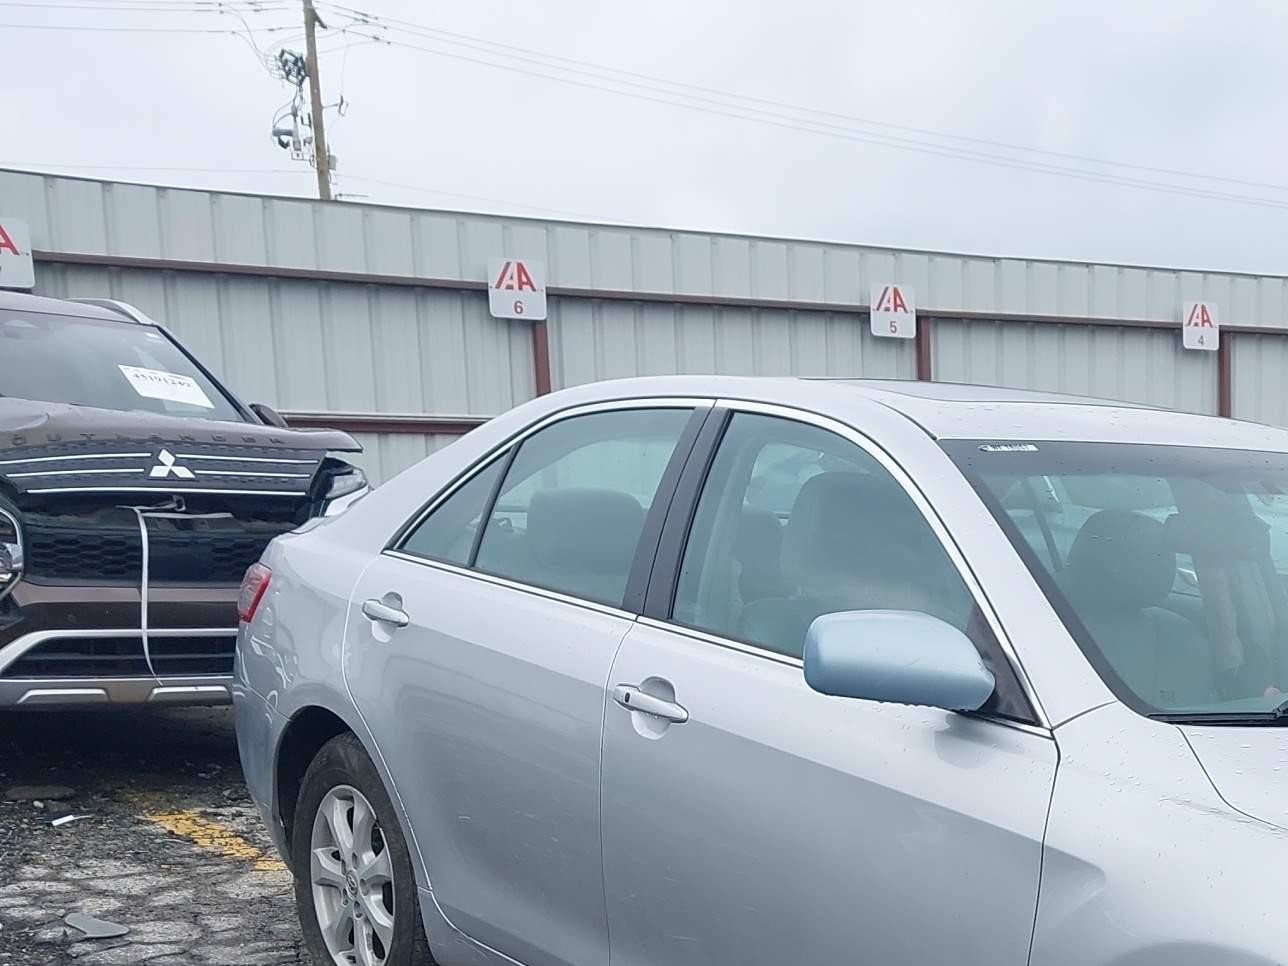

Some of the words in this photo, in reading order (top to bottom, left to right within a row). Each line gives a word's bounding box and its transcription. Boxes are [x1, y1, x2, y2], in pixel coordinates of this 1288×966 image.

[514, 300, 524, 315] 6
[890, 320, 898, 334] 5
[1197, 335, 1205, 346] 4
